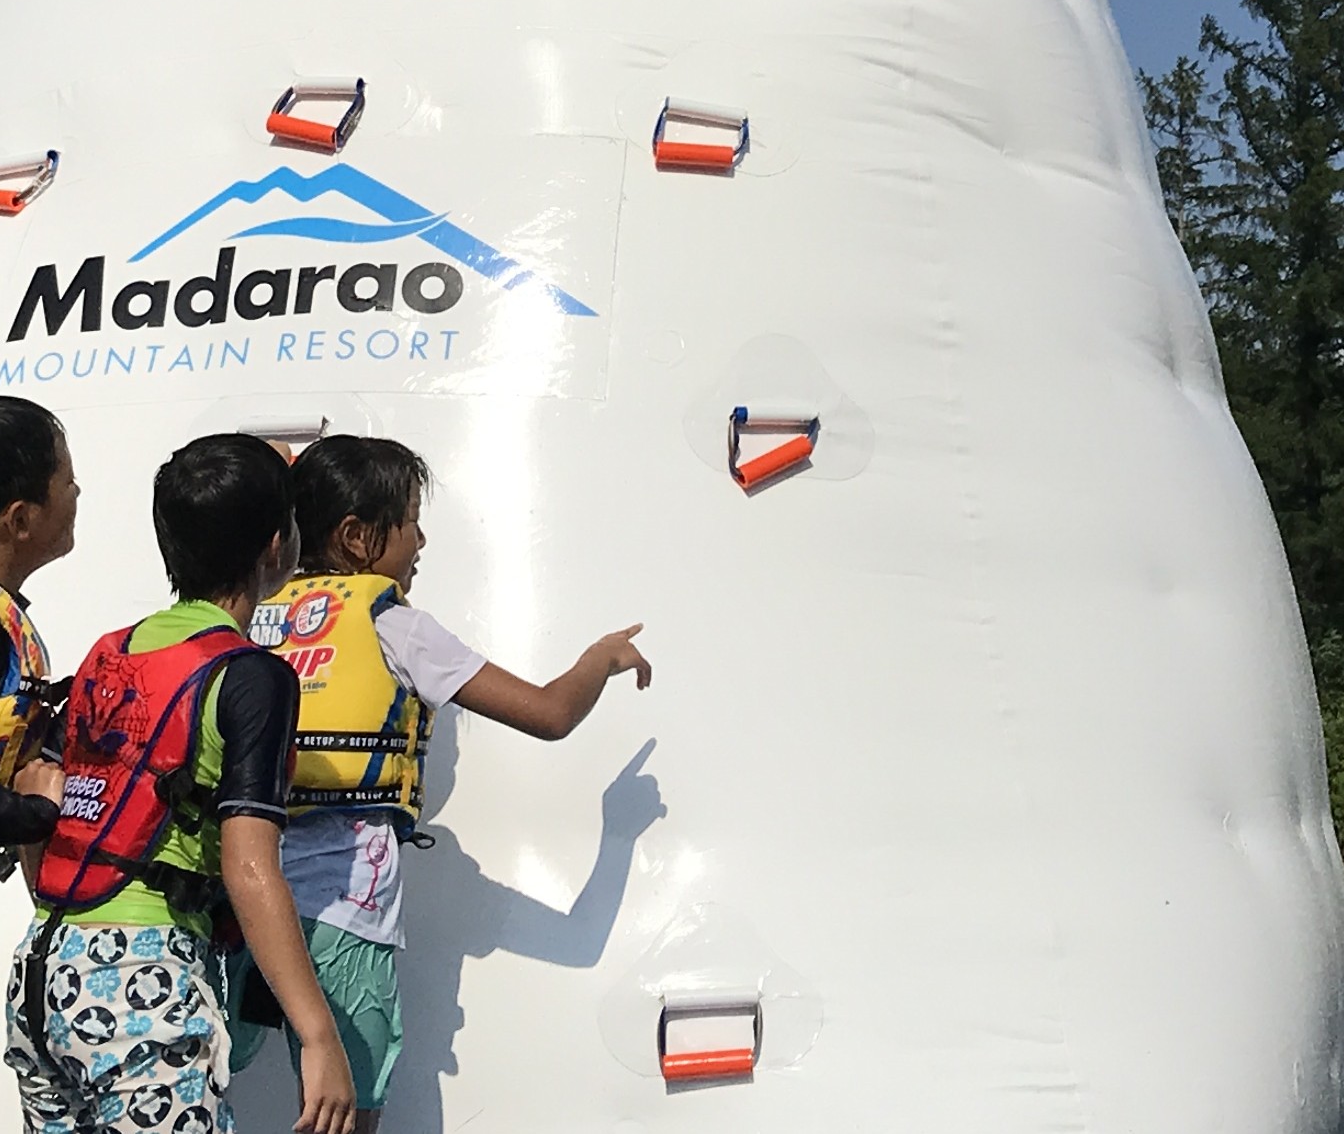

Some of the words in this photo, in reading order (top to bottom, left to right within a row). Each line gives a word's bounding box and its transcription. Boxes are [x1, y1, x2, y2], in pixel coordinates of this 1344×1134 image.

[6, 247, 463, 342] Madarao
[277, 330, 459, 361] RESORT
[250, 604, 290, 625] FETY
[64, 775, 107, 798] EBBED
[60, 796, 107, 821] NDER!
